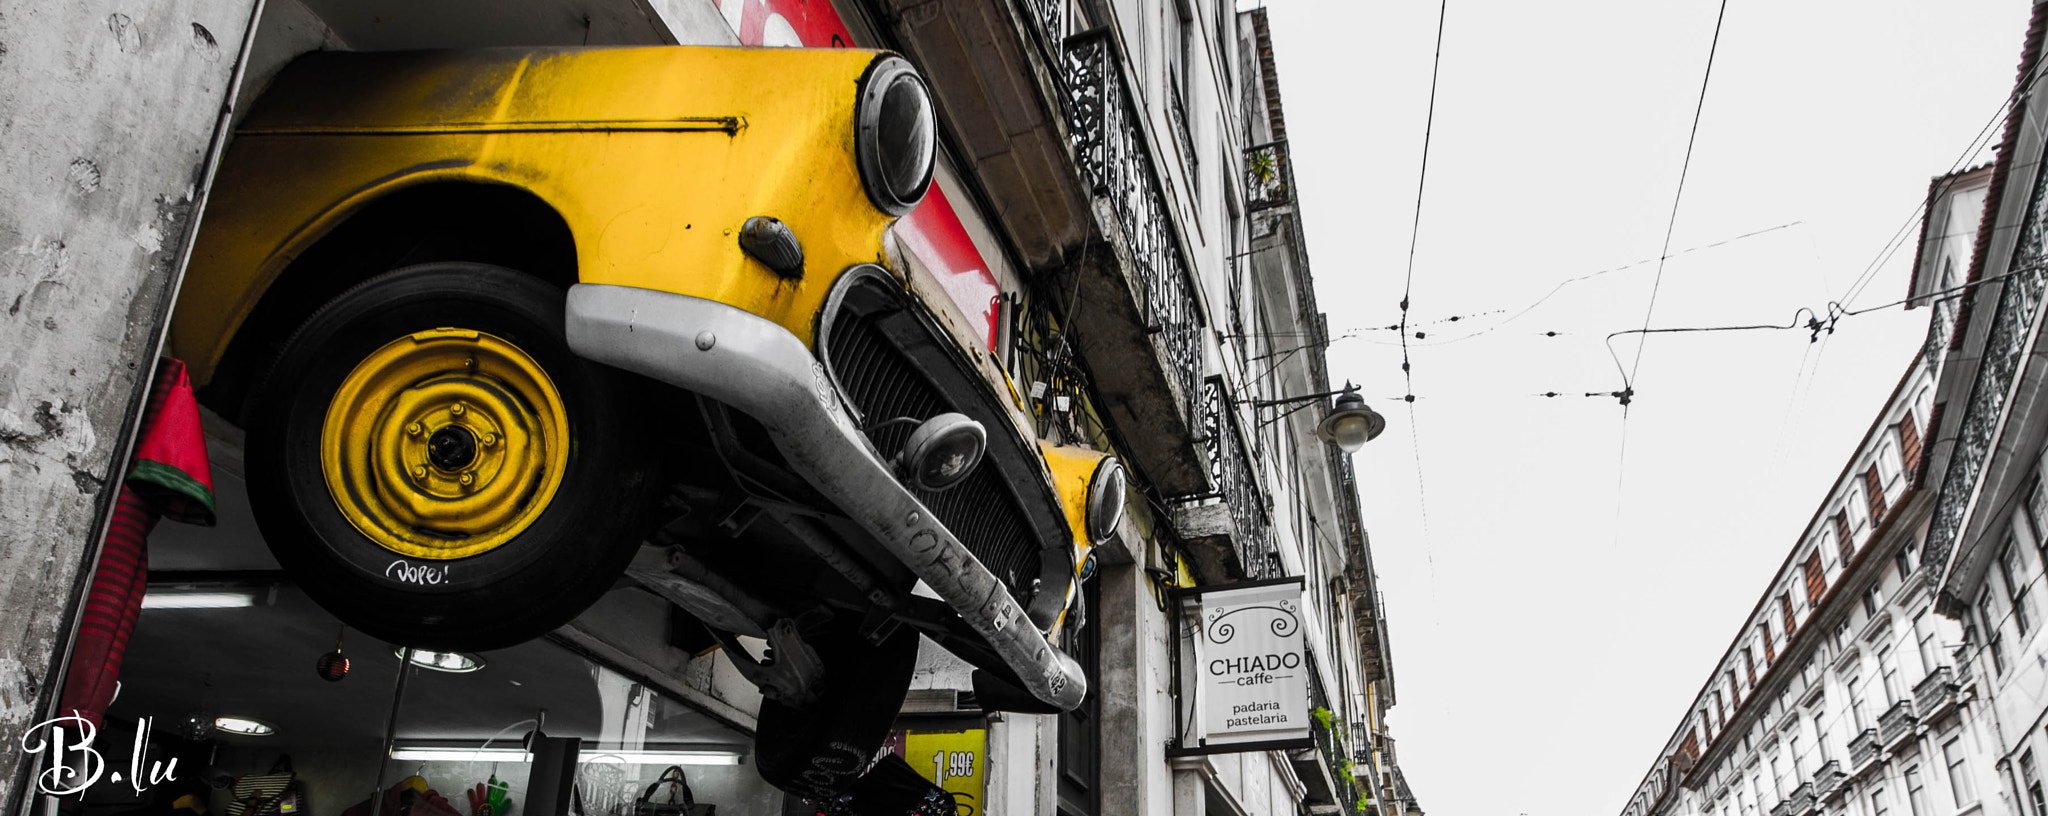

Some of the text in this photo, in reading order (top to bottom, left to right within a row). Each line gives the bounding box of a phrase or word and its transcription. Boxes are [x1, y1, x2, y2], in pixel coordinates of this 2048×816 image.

[1209, 652, 1300, 676] CHIADO
[1236, 672, 1273, 686] caffe
[1233, 701, 1280, 715] padaria
[1226, 713, 1288, 729] pastelaria
[933, 750, 974, 789] 1,99€
